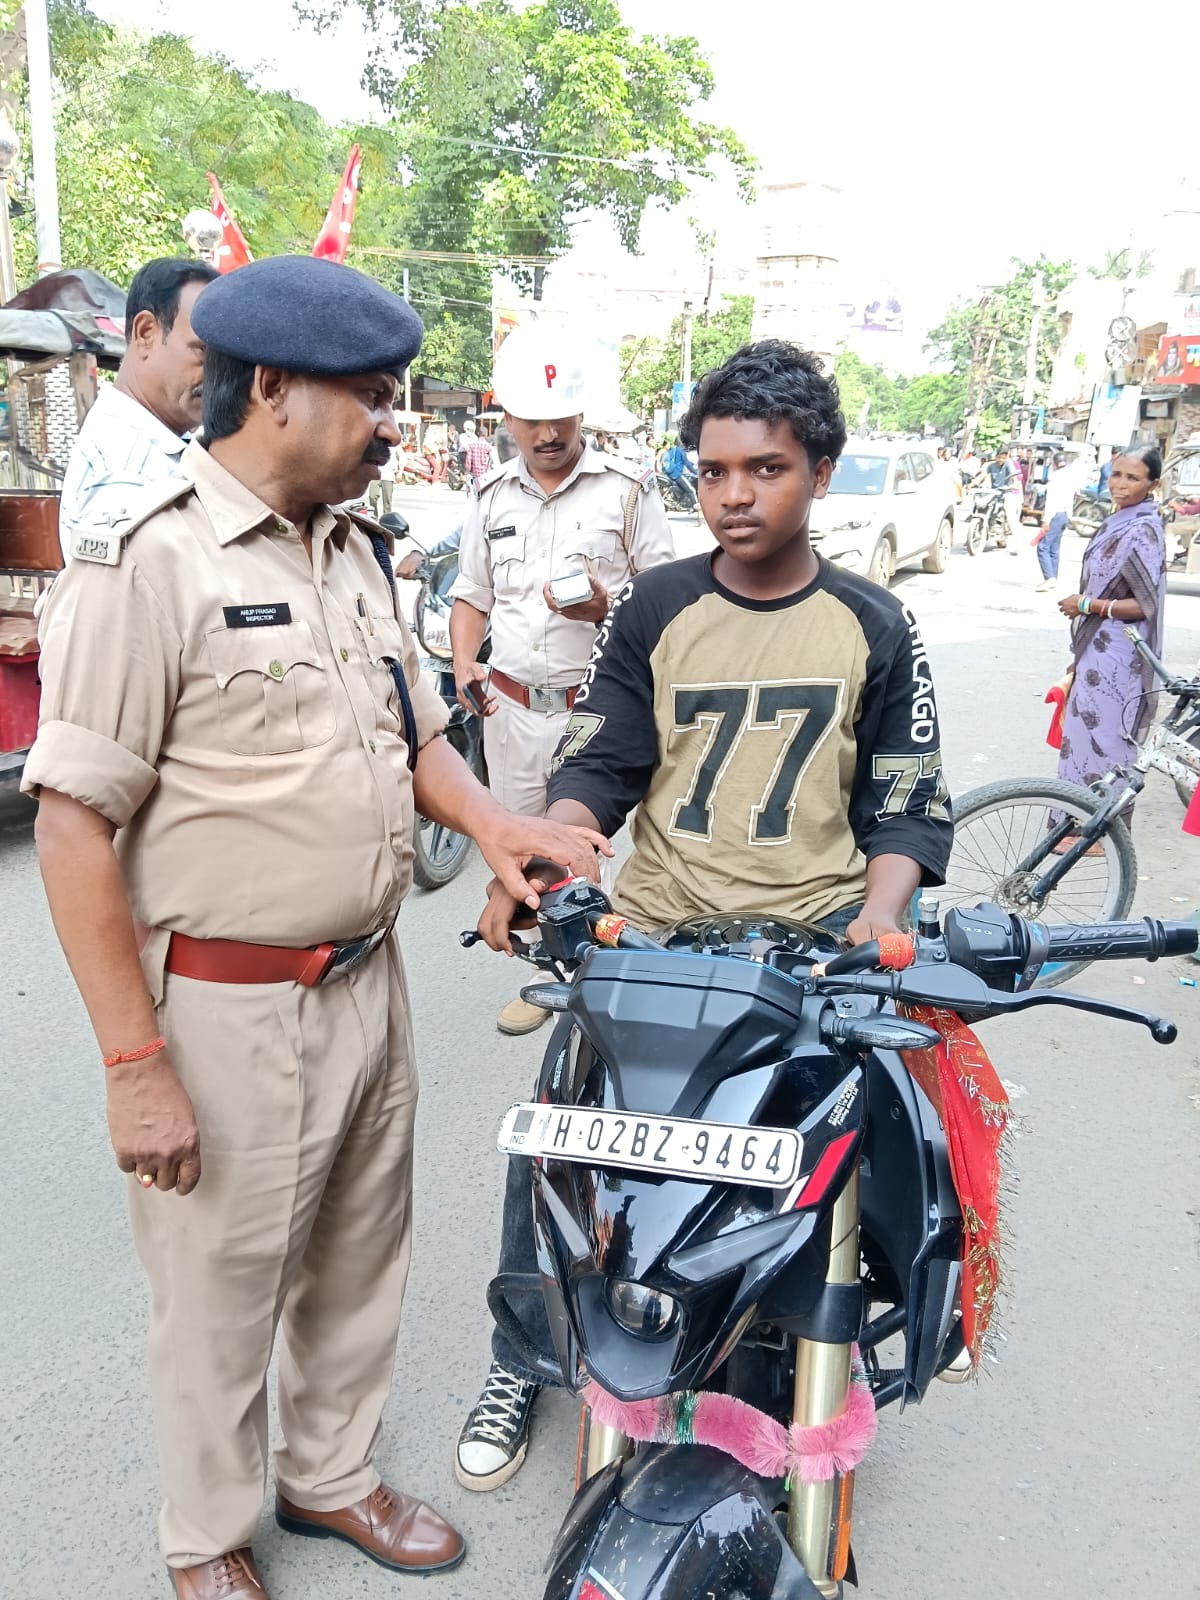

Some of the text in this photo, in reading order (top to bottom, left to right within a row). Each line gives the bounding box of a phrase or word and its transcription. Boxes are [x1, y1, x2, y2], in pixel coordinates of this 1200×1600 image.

[544, 364, 557, 388] P
[902, 604, 935, 743] CHICAGO
[667, 679, 846, 845] 77
[586, 1117, 674, 1163] 02BZ
[692, 1130, 784, 1176] 9464
